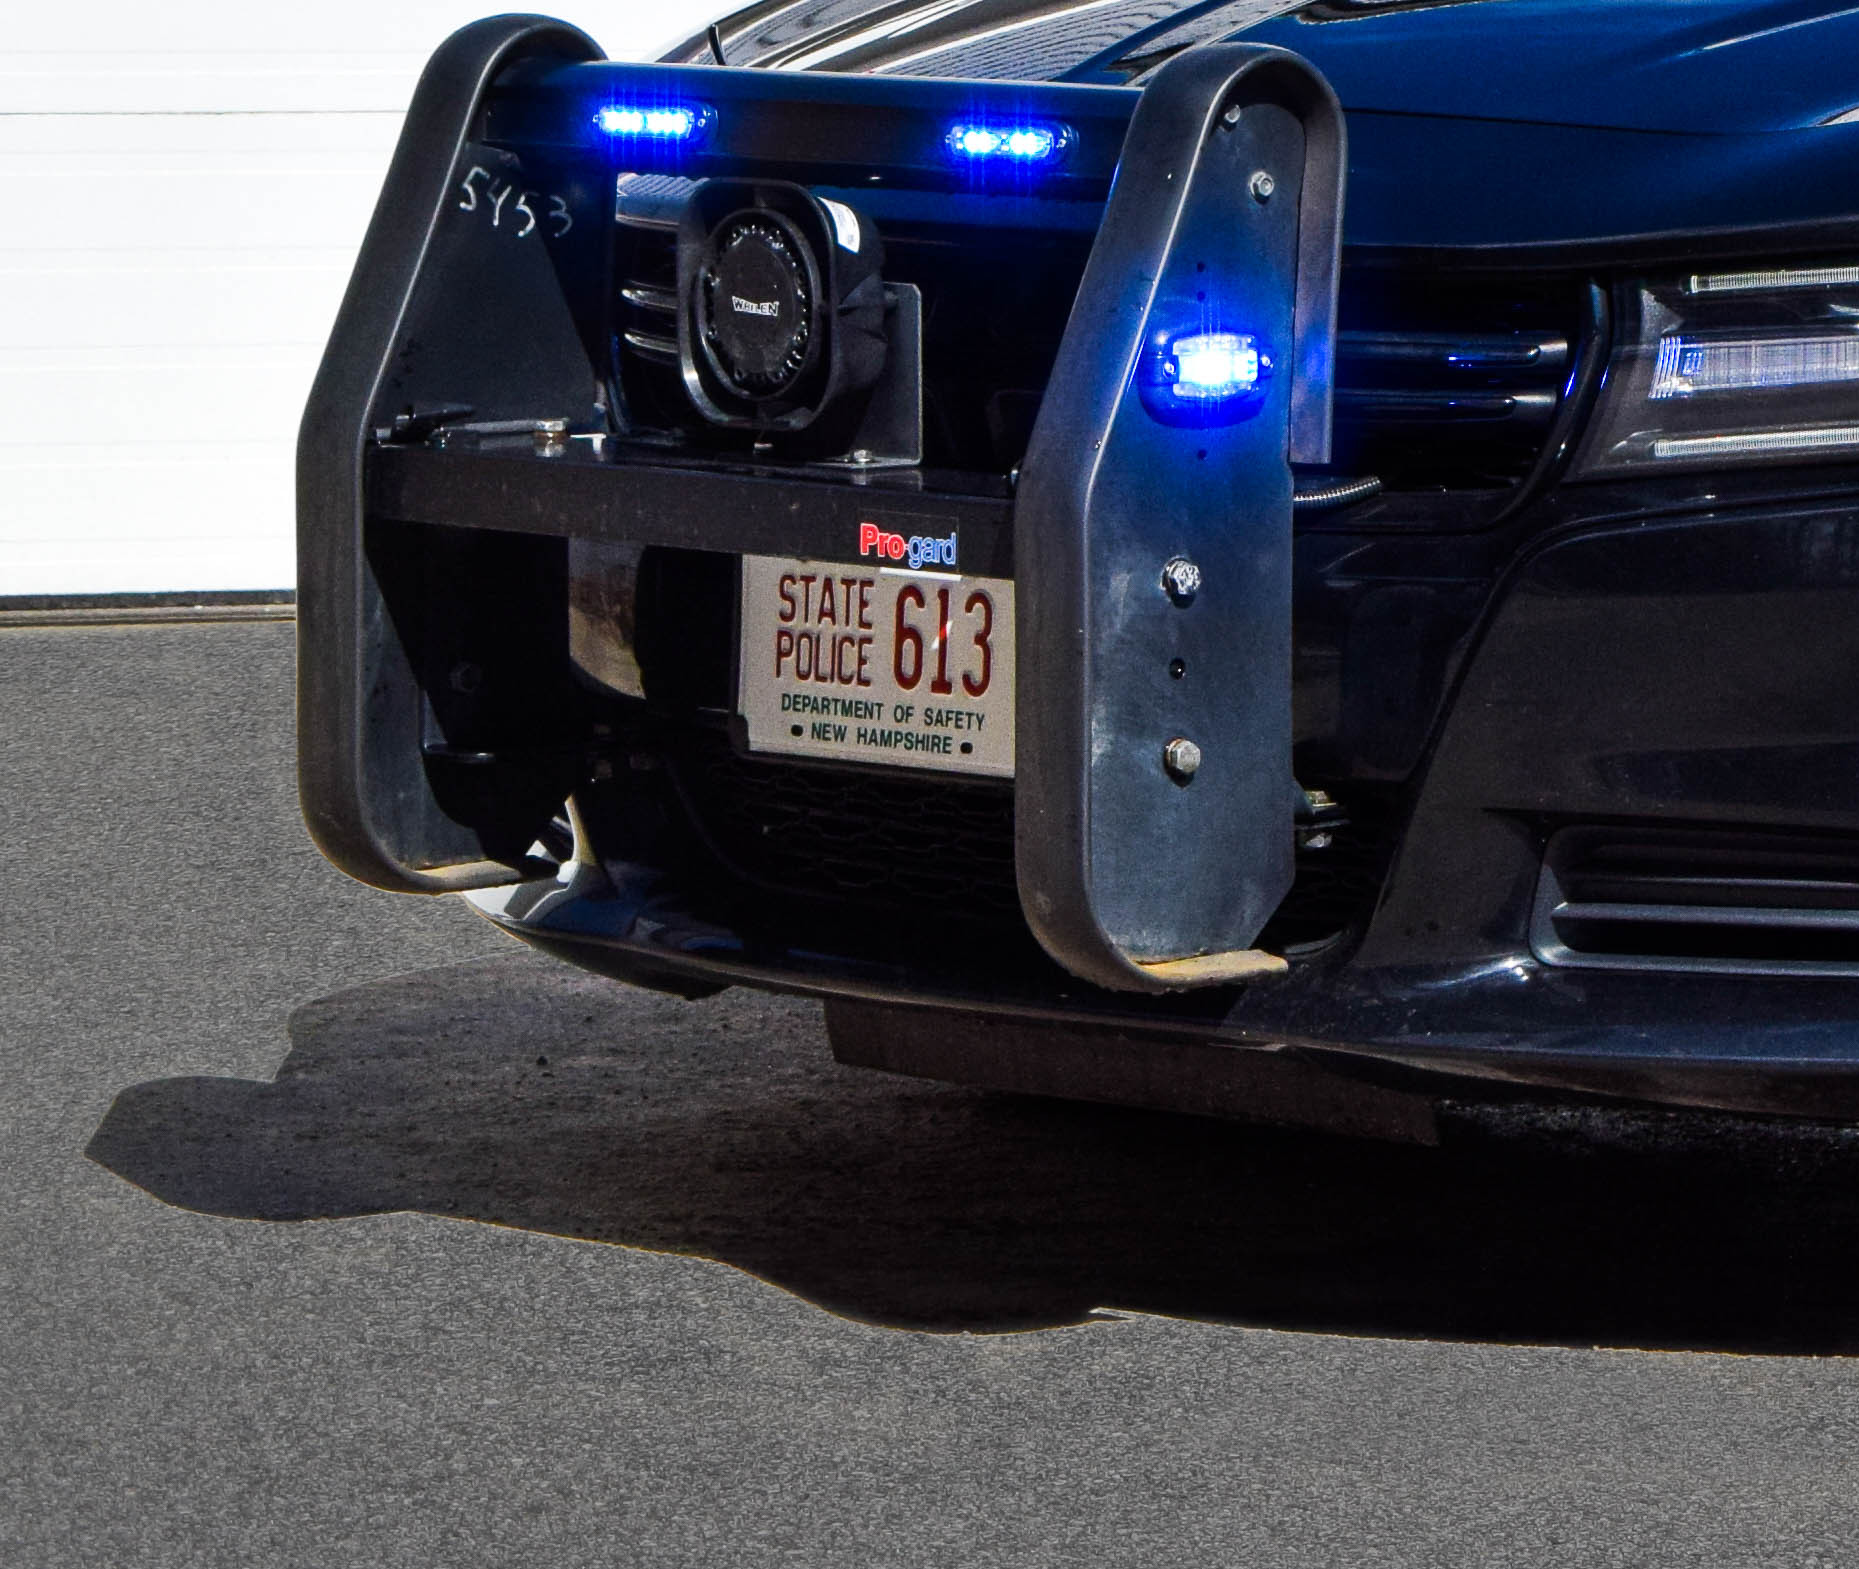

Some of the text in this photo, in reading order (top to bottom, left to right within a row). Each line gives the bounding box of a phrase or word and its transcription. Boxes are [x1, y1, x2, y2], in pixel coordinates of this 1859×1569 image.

[778, 574, 875, 631] STATE
[775, 629, 873, 687] POLICE
[892, 584, 994, 698] 613
[781, 693, 986, 732] DEPARTMENT OF SAFETY
[811, 722, 953, 755] NEW HAMPSHIRE
